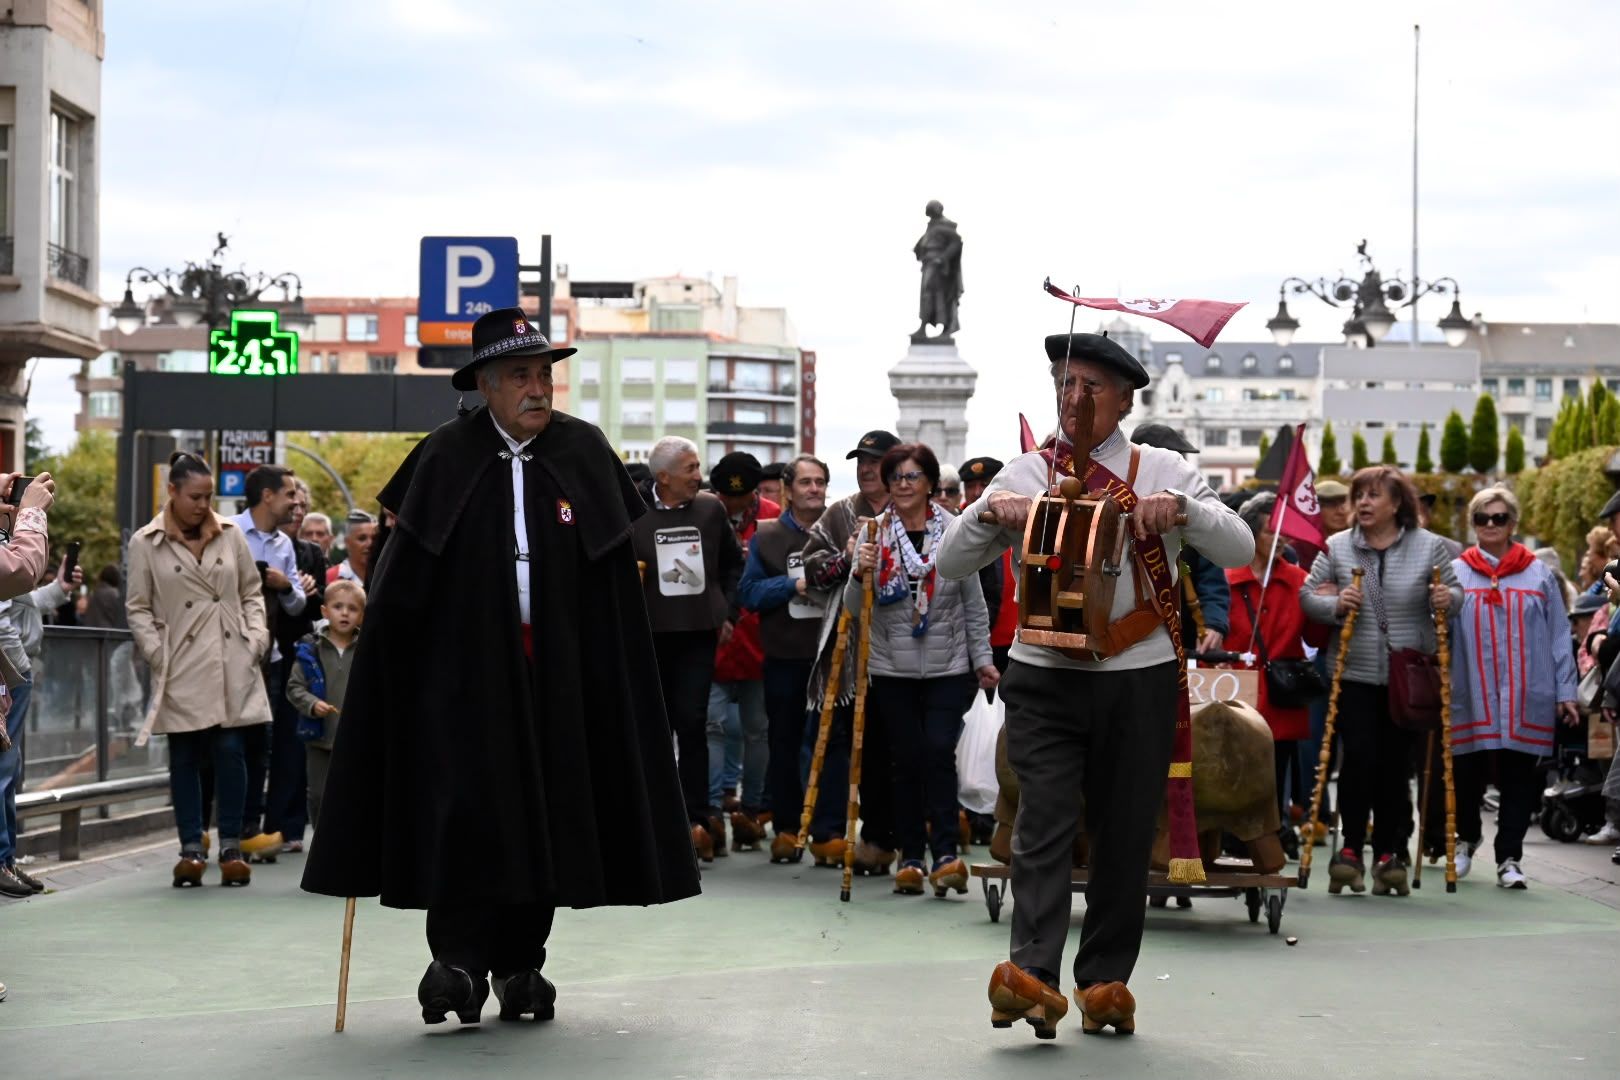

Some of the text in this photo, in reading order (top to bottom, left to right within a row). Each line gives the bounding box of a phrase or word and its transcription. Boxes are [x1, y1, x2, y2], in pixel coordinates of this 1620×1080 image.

[446, 246, 495, 315] P
[219, 446, 272, 463] TICKET
[225, 474, 239, 492] P
[1143, 546, 1166, 580] DE
